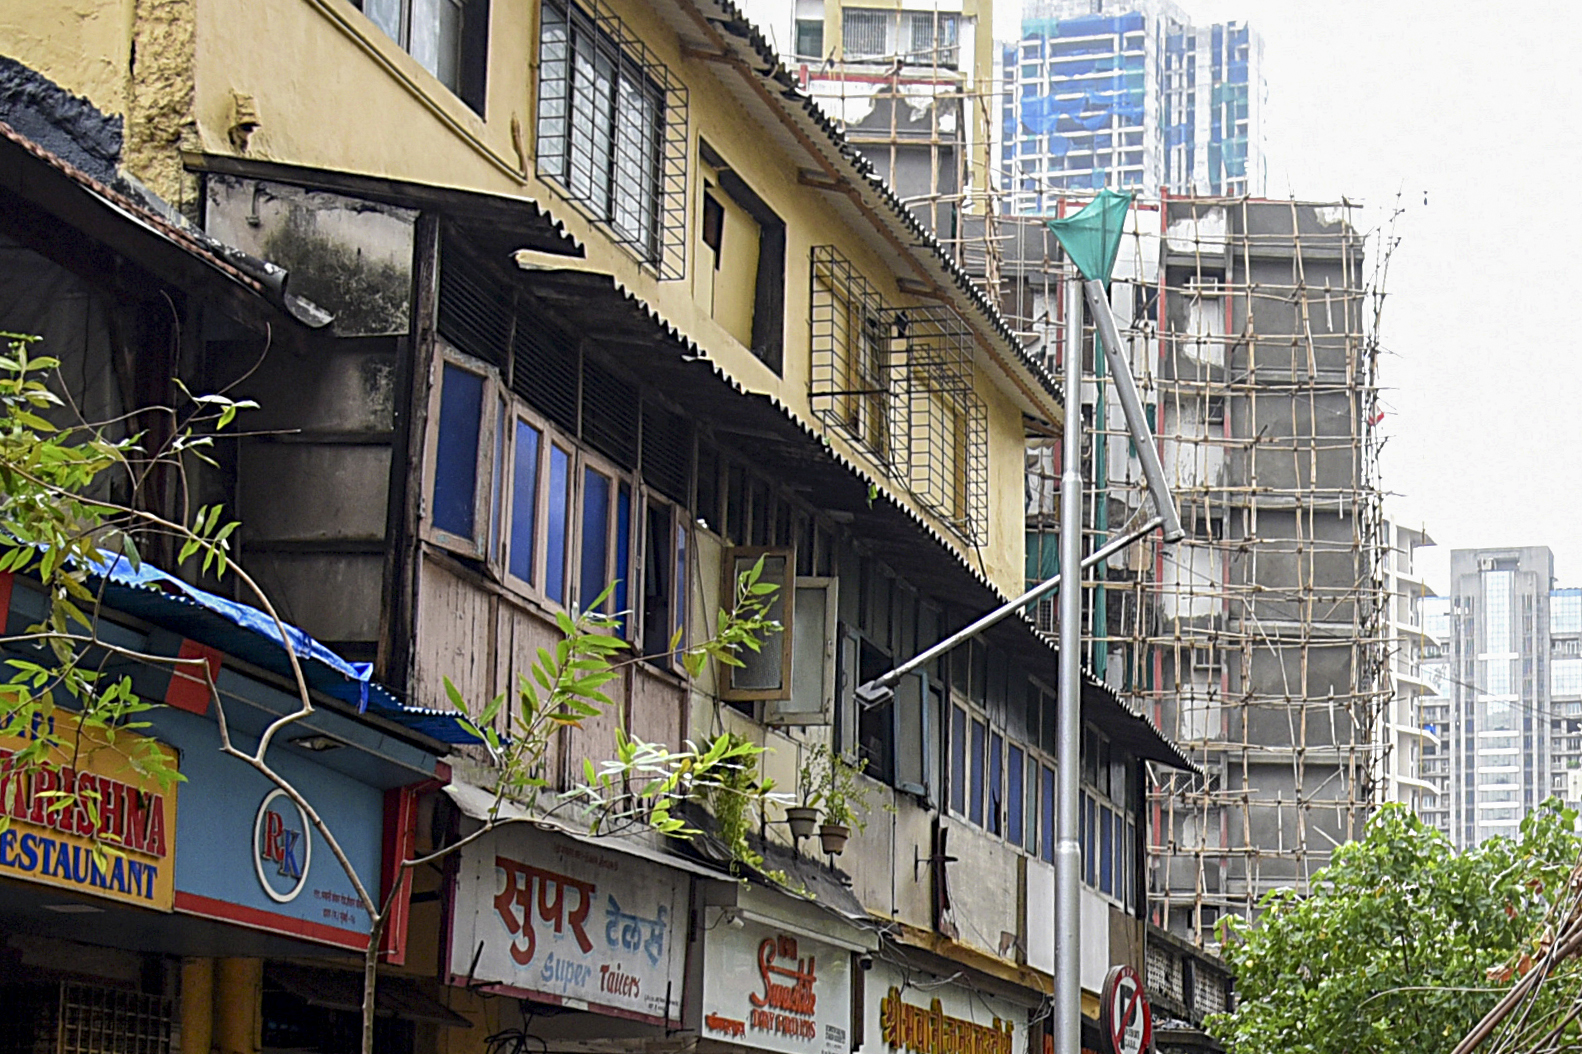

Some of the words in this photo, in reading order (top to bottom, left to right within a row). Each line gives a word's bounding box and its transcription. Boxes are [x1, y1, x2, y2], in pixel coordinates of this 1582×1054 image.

[493, 855, 596, 966] सुपर
[606, 894, 668, 966] टेलर्स
[541, 952, 592, 993] Super
[751, 1008, 775, 1031] DRY
